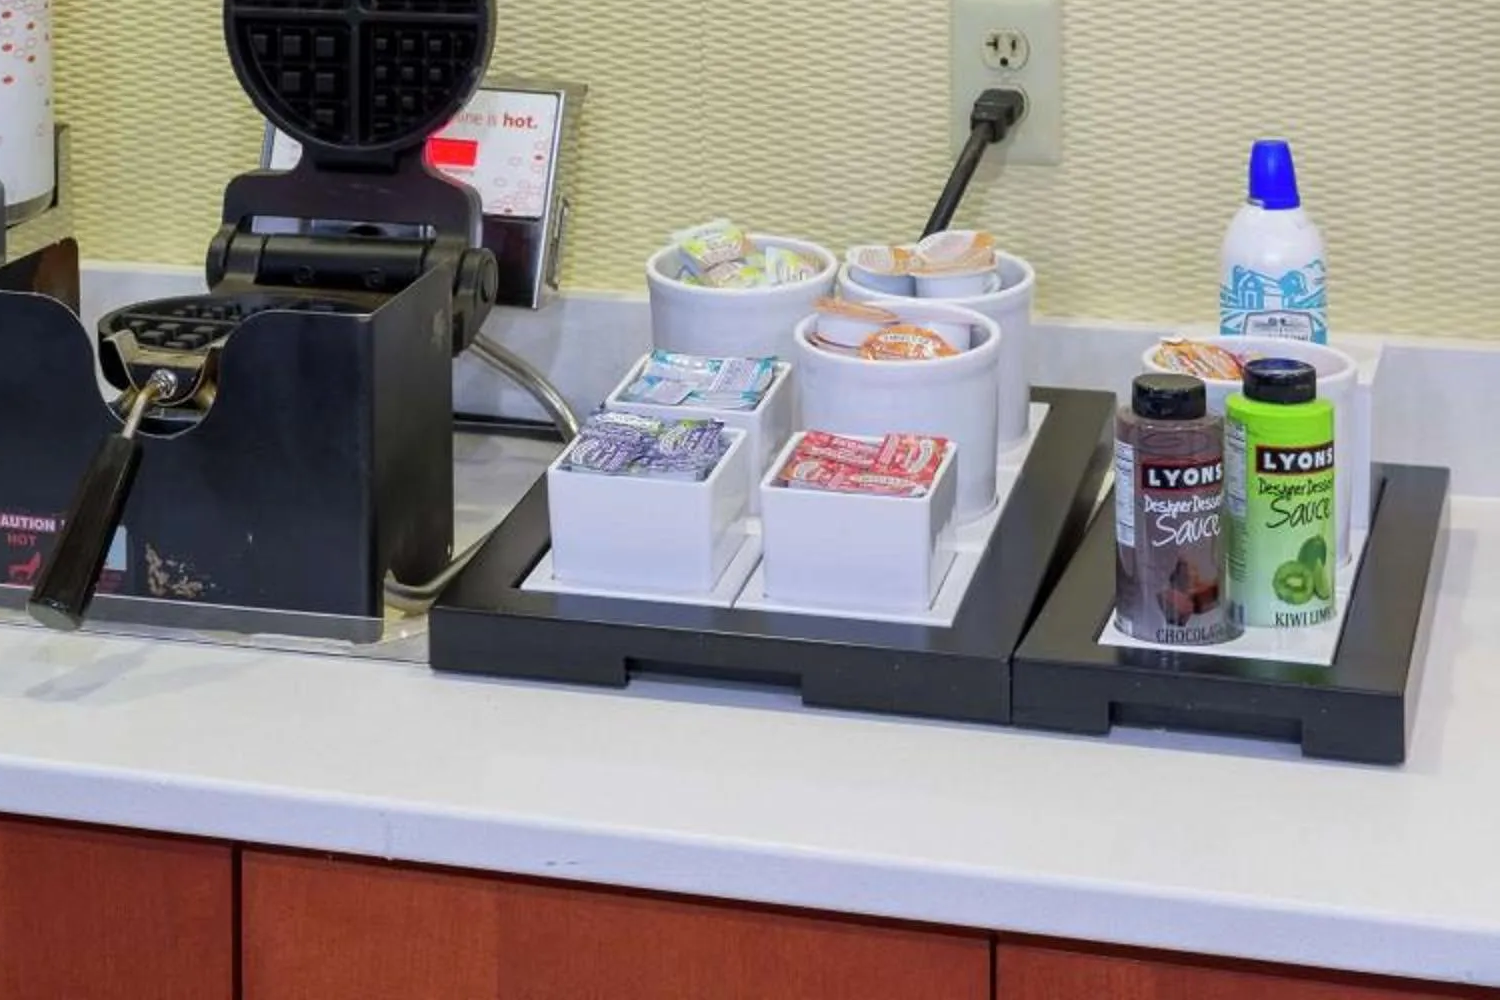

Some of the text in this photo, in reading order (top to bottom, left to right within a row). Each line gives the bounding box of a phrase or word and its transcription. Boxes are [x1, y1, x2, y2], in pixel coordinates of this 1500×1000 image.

[503, 111, 538, 129] hot.
[1262, 447, 1333, 471] LYONS
[1148, 462, 1223, 486] LYONS
[1266, 497, 1331, 528] Sauce
[7, 533, 36, 546] HOT
[1151, 513, 1221, 546] Sauce
[1274, 609, 1309, 628] KIWI
